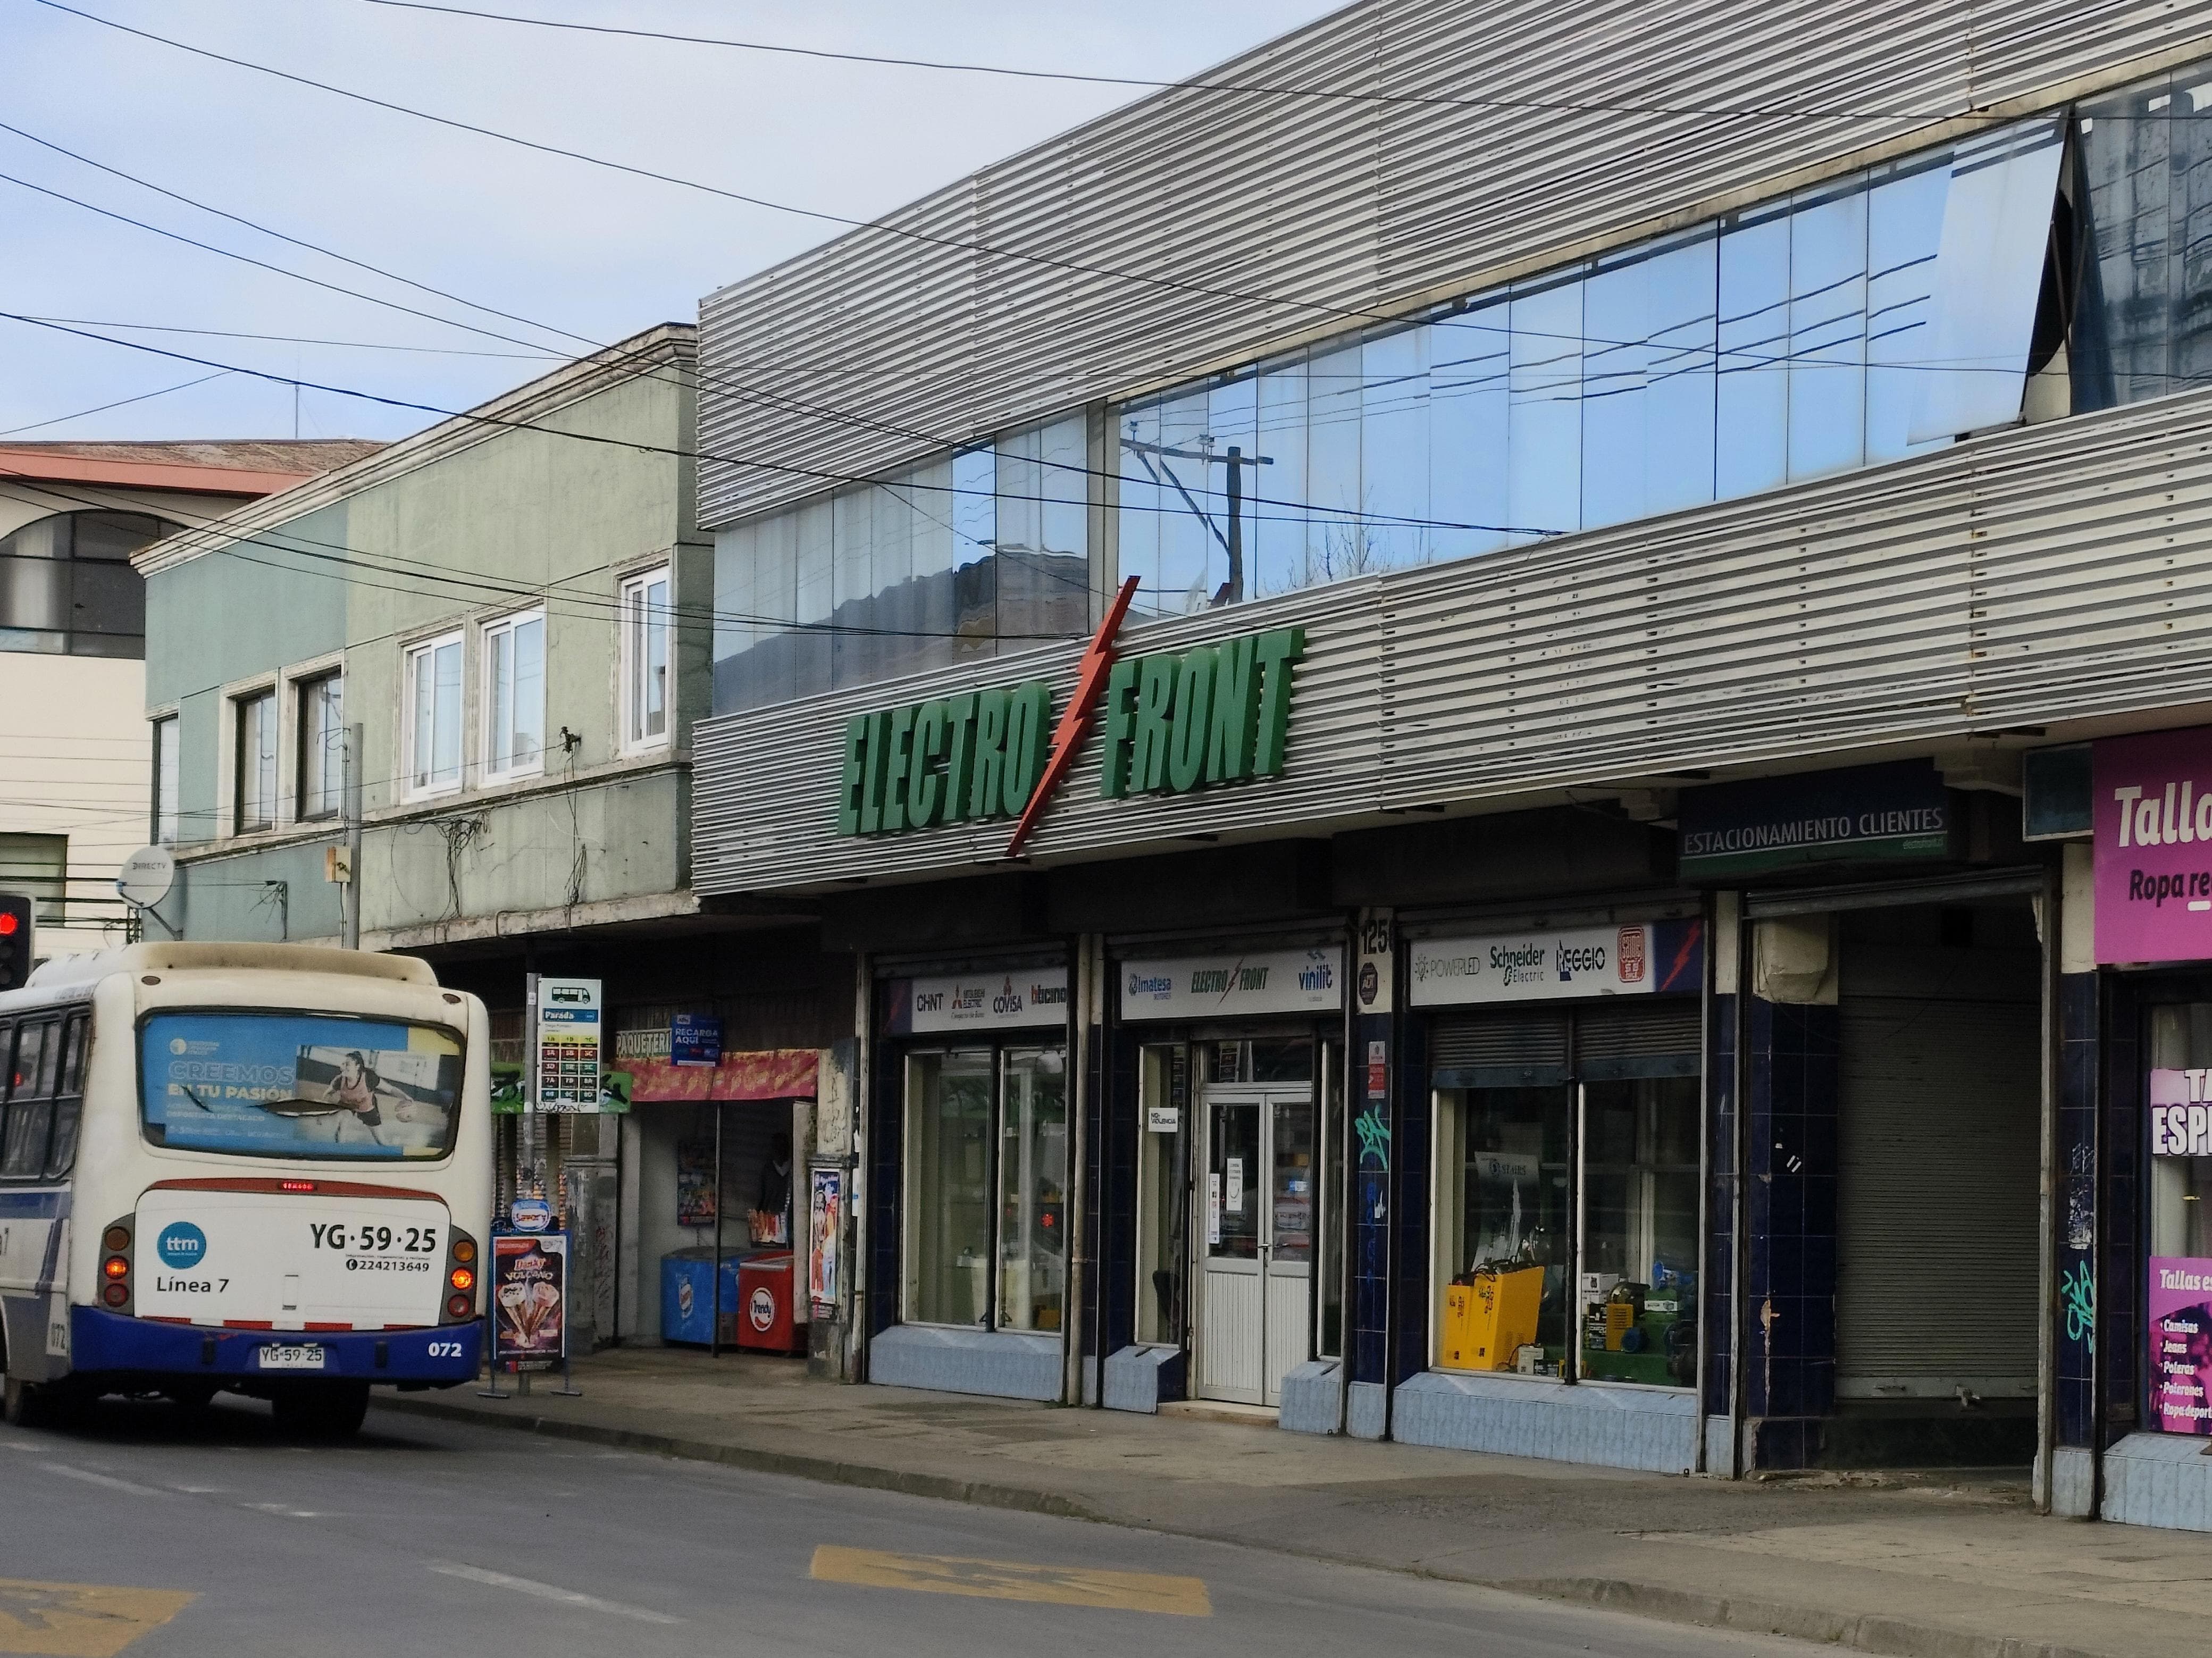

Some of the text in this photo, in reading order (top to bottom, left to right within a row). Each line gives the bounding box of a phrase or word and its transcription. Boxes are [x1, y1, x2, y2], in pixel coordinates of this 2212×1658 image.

[837, 628, 1305, 835] ELECTRO FRONT
[2115, 781, 2212, 848] Talla
[1685, 807, 1943, 856] ESTACIONAMIENTO CLIENTES
[2130, 869, 2184, 908] Ropa
[1490, 943, 1545, 969] Schneider
[1191, 967, 1269, 993] ELECTRO FRONT
[1298, 963, 1333, 991] vinilit
[1513, 969, 1544, 983] Electric
[993, 995, 1023, 1014] COVISA
[545, 1011, 574, 1020] Parada
[675, 1028, 718, 1037] RECARGA
[169, 1061, 296, 1085] CREEMOS
[168, 1083, 292, 1101] EN TU PASIÓN
[166, 1237, 198, 1251] ttm
[359, 1261, 430, 1272] 224213649
[157, 1276, 229, 1293] Línea 7
[2160, 1269, 2201, 1291] Tallas
[2164, 1319, 2199, 1333] Camisas
[428, 1342, 462, 1358] 072
[2164, 1340, 2187, 1354] Jeans
[2164, 1361, 2195, 1375] Poleras
[2163, 1381, 2204, 1397] Polerones
